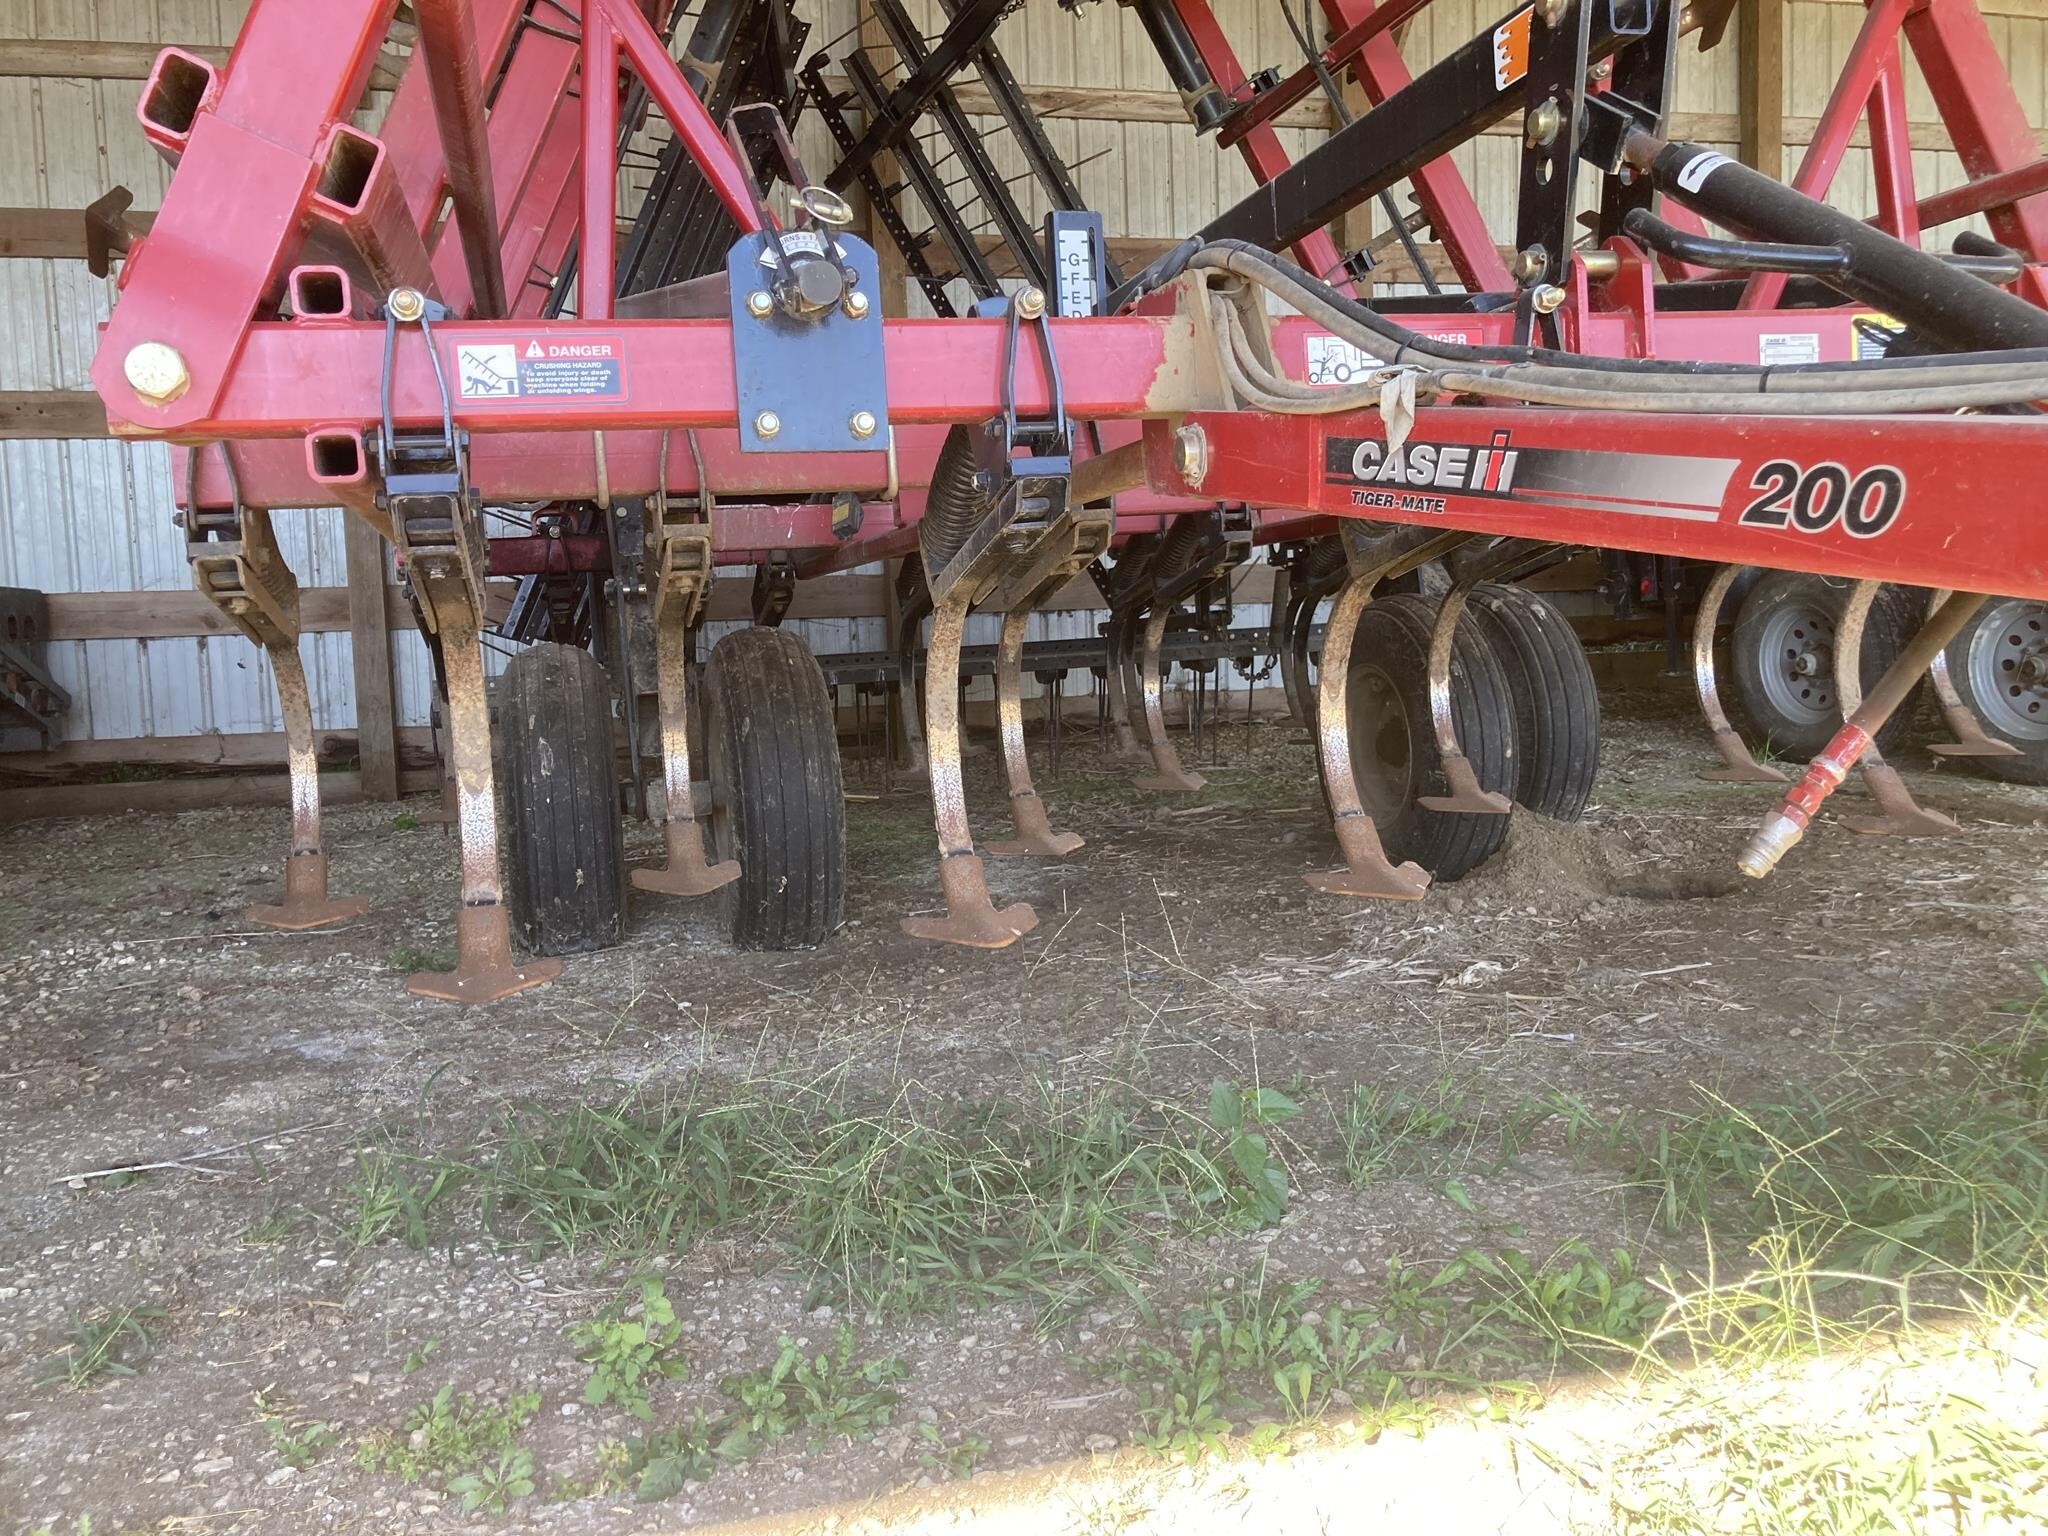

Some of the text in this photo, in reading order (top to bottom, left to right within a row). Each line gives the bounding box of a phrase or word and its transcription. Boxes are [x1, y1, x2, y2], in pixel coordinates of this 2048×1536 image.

[1068, 253, 1080, 267] G
[1071, 272, 1080, 286] F
[1072, 291, 1081, 305] E
[548, 345, 612, 357] DANGER
[534, 362, 571, 370] CRUSHING
[558, 370, 579, 378] injury
[537, 387, 572, 395] unfolding
[1352, 441, 1471, 488] CASE
[1351, 491, 1445, 514] TIGER-MATE
[1738, 459, 1907, 539] 200
